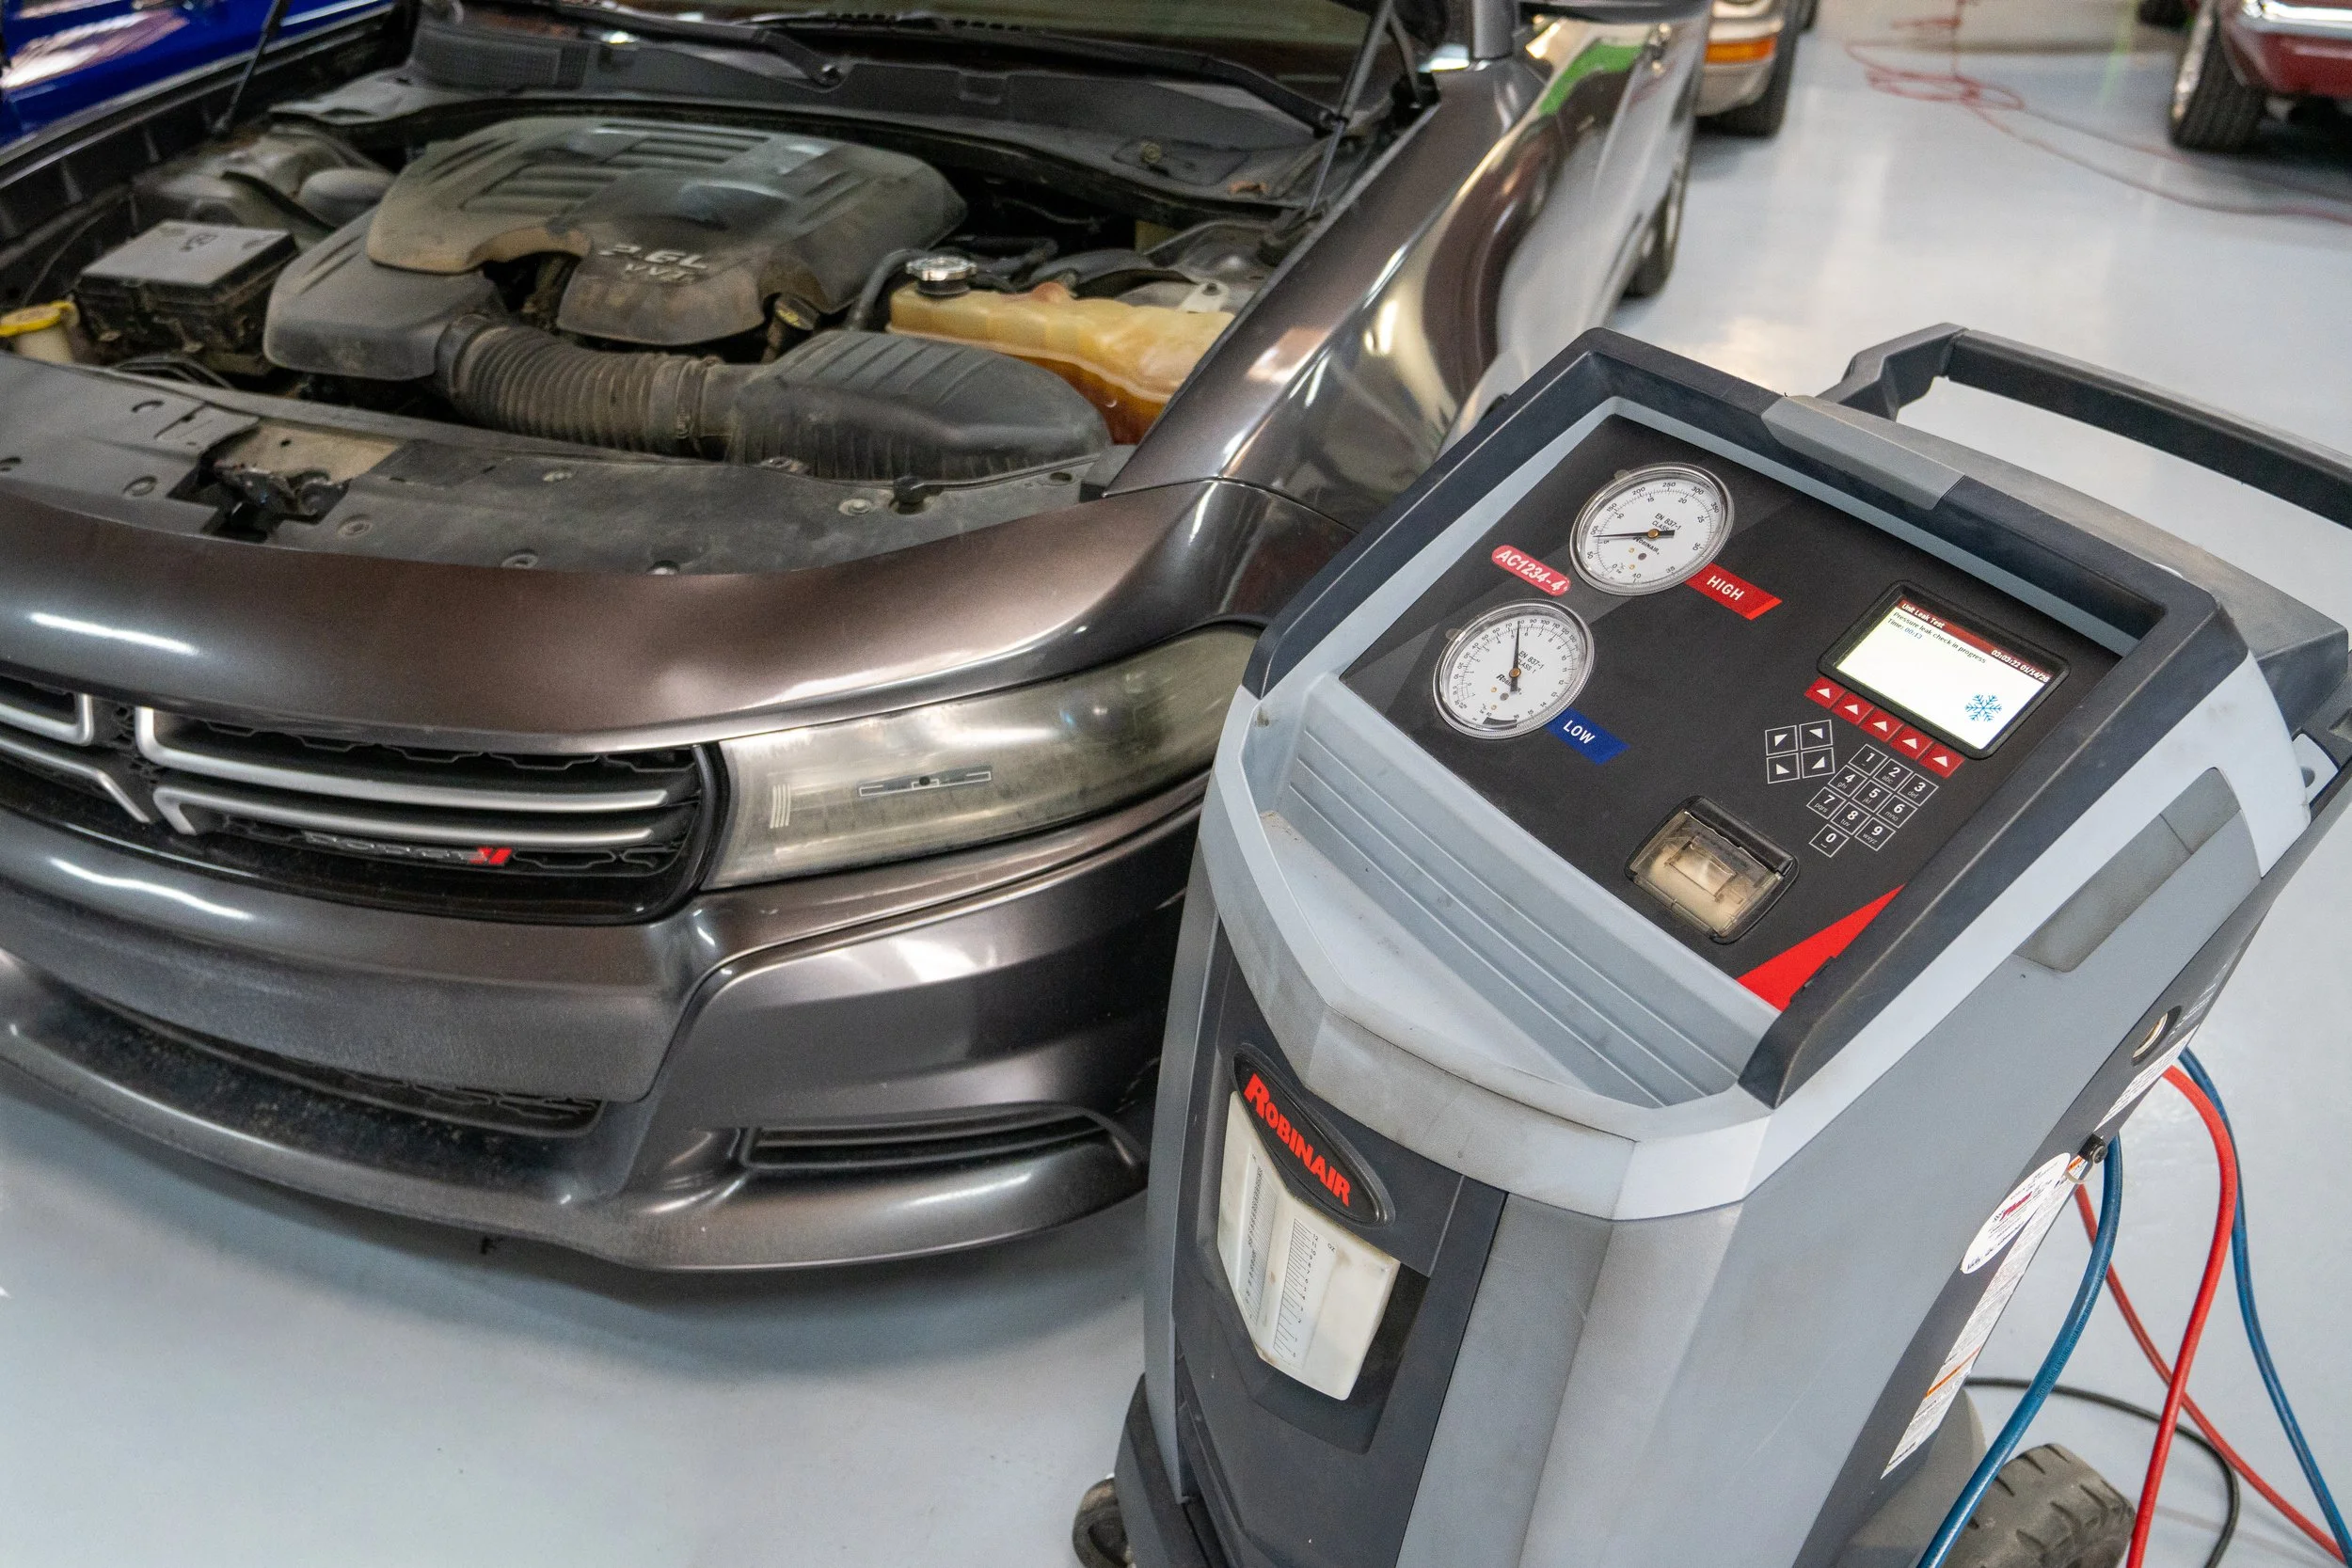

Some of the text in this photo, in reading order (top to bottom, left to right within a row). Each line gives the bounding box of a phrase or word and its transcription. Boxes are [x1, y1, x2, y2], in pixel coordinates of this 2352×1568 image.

[1631, 486, 1645, 496] 200
[1691, 485, 1705, 496] 300
[1606, 502, 1617, 513] 150
[1710, 501, 1720, 514] 350
[1654, 513, 1682, 531] EN 837-1
[1697, 515, 1705, 524] 25
[1692, 542, 1701, 551] 30
[1495, 548, 1564, 592] AC1234-4
[1665, 565, 1676, 574] 35
[1706, 575, 1745, 601] HIGH
[1901, 603, 1946, 629] Unit Leak Test
[1887, 618, 1904, 630] Time:
[1893, 611, 1920, 629] Pressure
[1919, 625, 1932, 636] leak
[1932, 632, 1951, 645] check
[1958, 646, 1987, 664] progress
[1563, 720, 1596, 745] LOW
[1866, 752, 1875, 762] 1
[1888, 767, 1900, 778] 2
[1845, 773, 1856, 784] 4
[1882, 775, 1894, 784] abc
[1914, 782, 1926, 792] 3
[1868, 788, 1881, 798] 5
[1907, 790, 1919, 799] def
[1823, 794, 1836, 804] 7
[1862, 795, 1871, 804] jkl
[1814, 802, 1828, 813] pqrs
[1893, 803, 1905, 814] 6
[1847, 810, 1859, 820] 8
[1884, 811, 1899, 821] mno
[1840, 818, 1851, 827] tuv
[1871, 826, 1883, 836] 9
[1825, 832, 1836, 843] 0
[1862, 832, 1878, 845] wxyz
[1243, 1072, 1351, 1207] ROBINAIR
